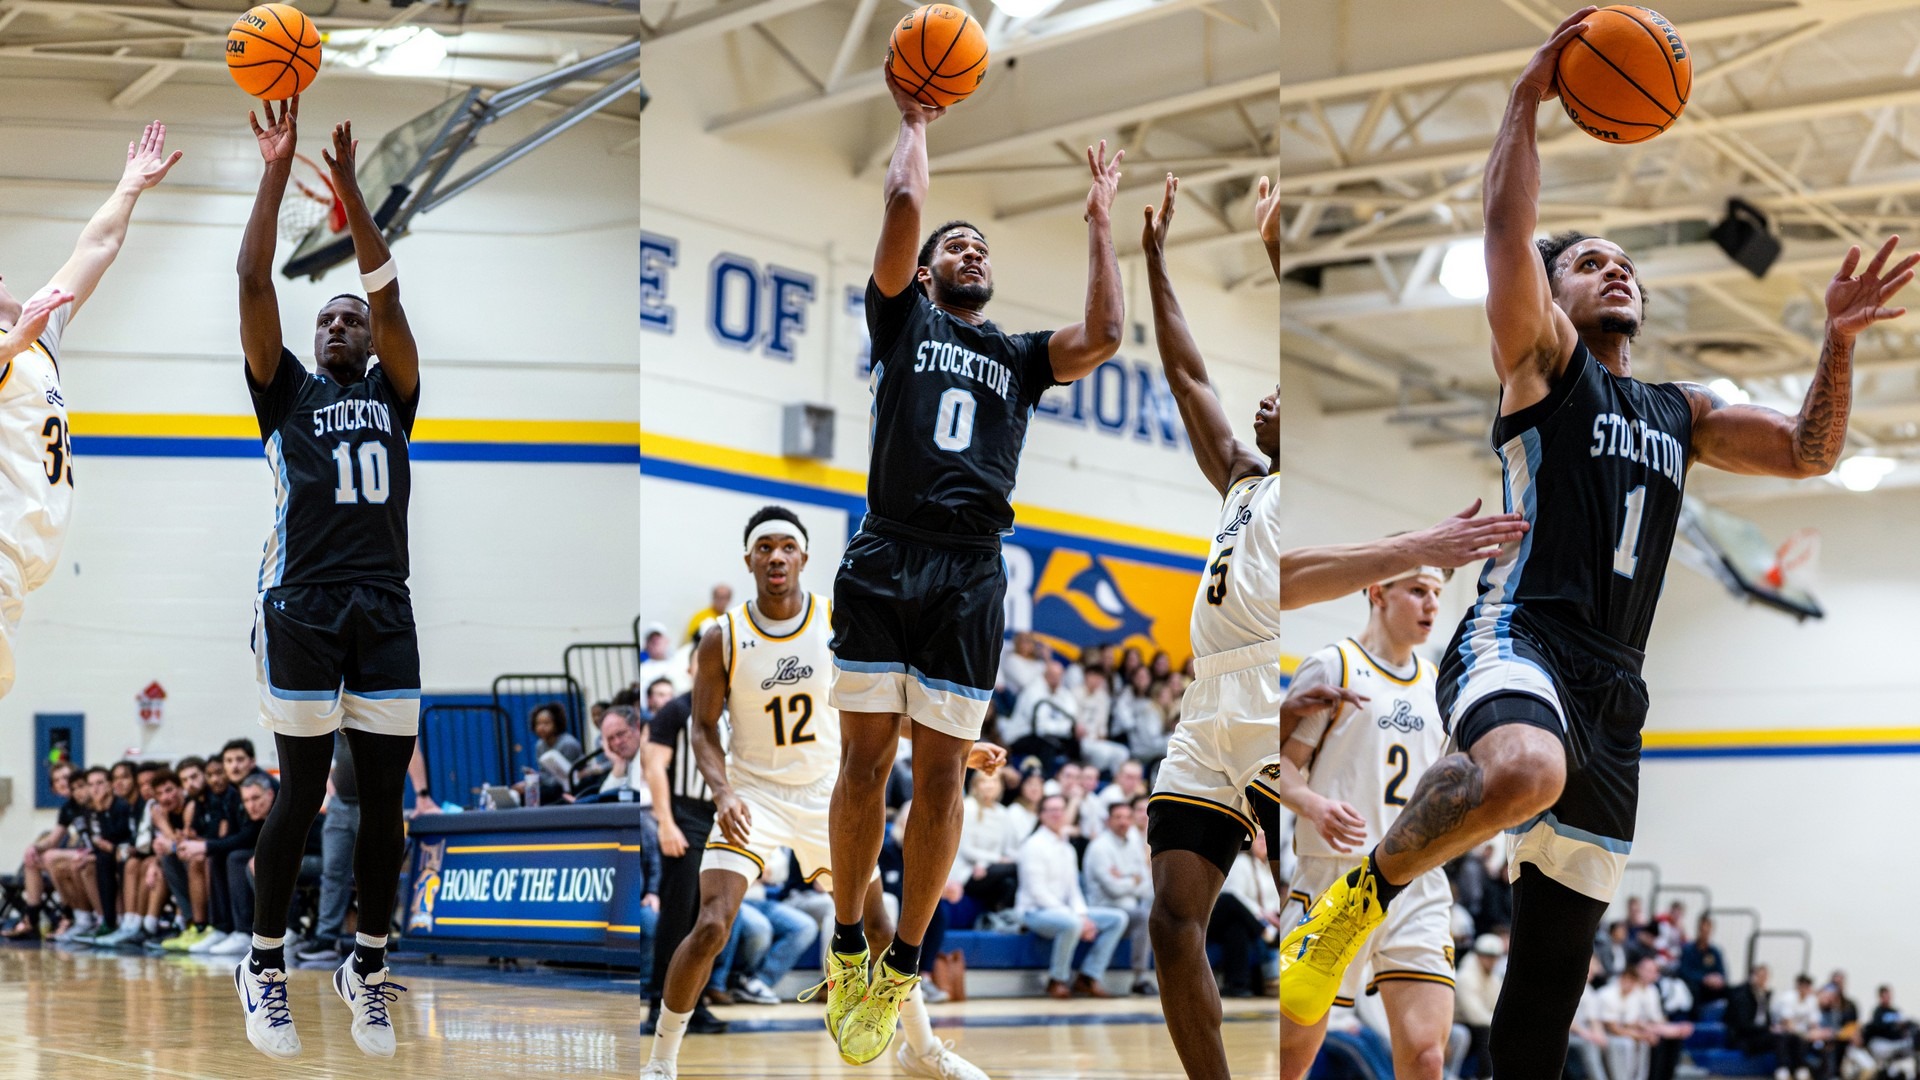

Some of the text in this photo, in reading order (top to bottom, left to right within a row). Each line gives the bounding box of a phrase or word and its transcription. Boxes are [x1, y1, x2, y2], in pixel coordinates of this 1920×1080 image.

[706, 250, 817, 363] OF
[914, 339, 1012, 401] STOCKTON
[313, 398, 392, 438] STOCKTON
[933, 387, 977, 453] 0
[332, 440, 390, 505] 10
[1589, 413, 1684, 492] STOCKTON
[1613, 485, 1647, 580] 1
[1207, 546, 1234, 606] 5
[761, 655, 814, 691] Lions
[764, 691, 817, 747] 12
[1378, 699, 1424, 733] Lions
[1384, 743, 1410, 808] 2
[440, 867, 616, 902] HOME OF THE LIONS
